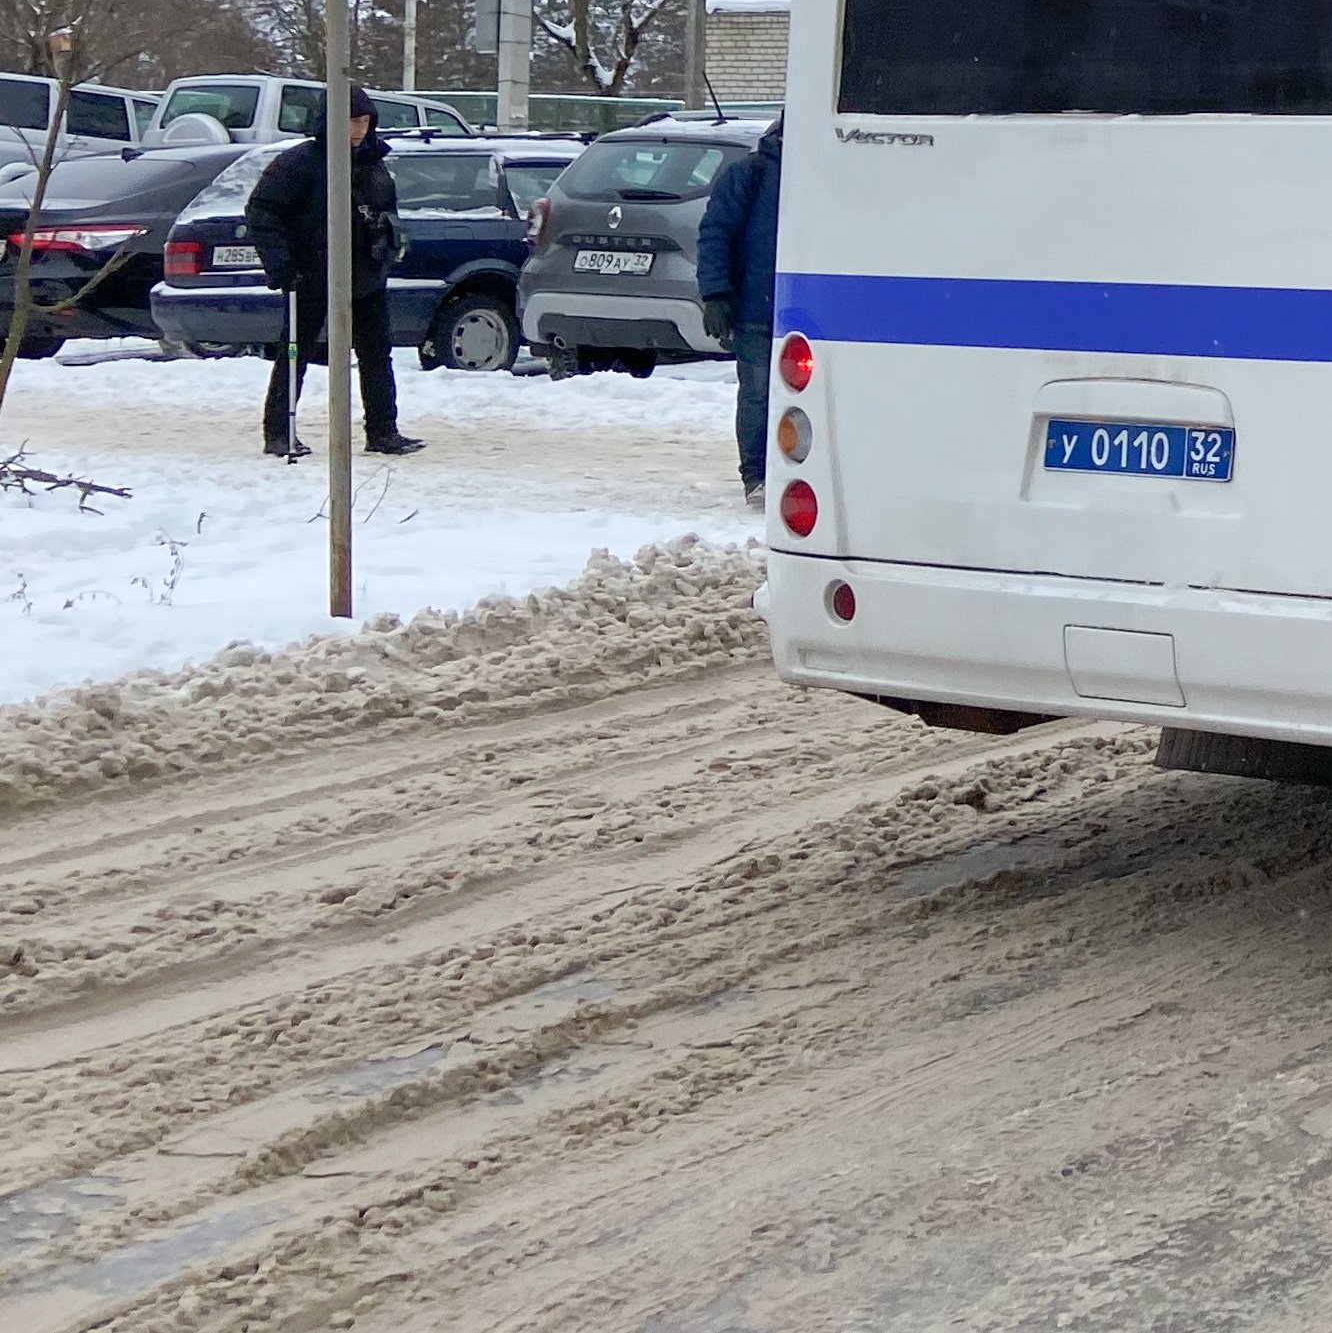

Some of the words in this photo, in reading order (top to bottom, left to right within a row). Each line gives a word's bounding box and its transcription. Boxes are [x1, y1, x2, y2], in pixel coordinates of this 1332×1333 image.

[633, 254, 649, 267] 32
[1091, 428, 1169, 470] 0110
[1190, 431, 1222, 463] 32
[1192, 462, 1216, 476] RUS
